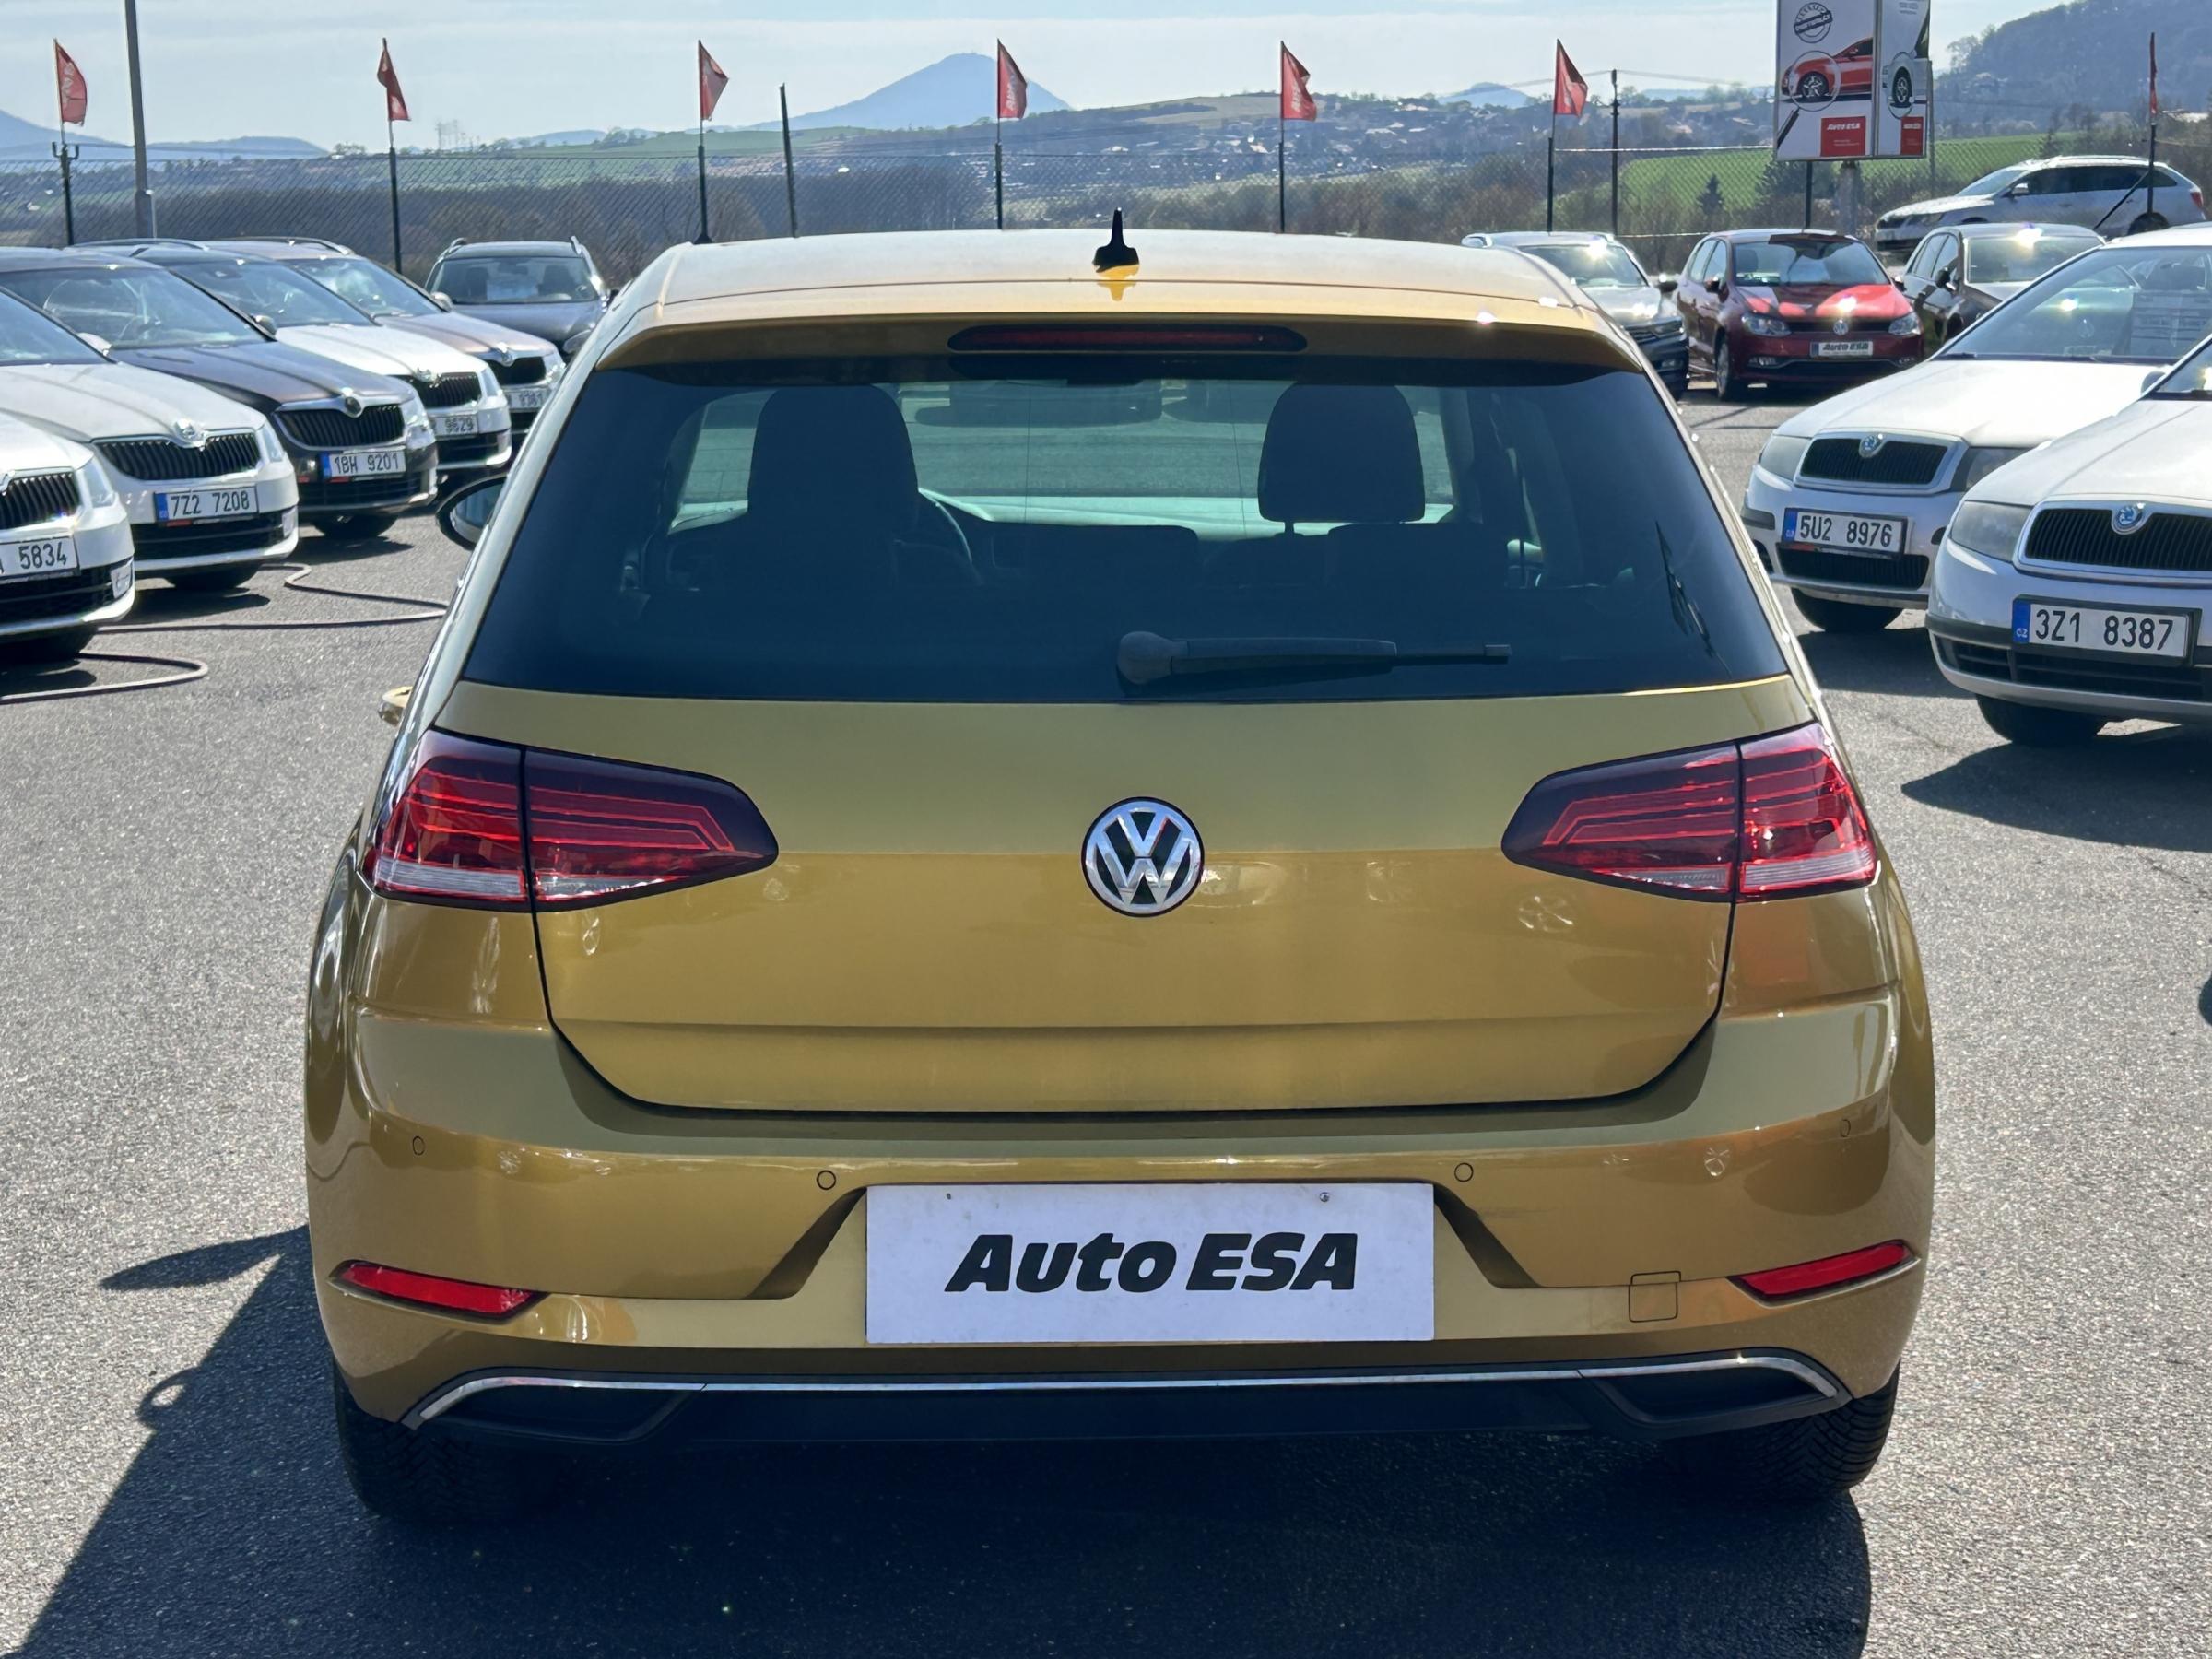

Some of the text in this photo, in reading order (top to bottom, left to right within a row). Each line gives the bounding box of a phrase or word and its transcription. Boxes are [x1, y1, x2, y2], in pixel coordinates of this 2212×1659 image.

[367, 453, 399, 472] 9201
[171, 490, 250, 517] 7Z2 7208
[1800, 514, 1892, 547] 5U2 8976
[18, 541, 67, 570] 5834
[2035, 608, 2081, 643] 3Z1
[2103, 615, 2173, 651] 8387
[944, 1232, 1358, 1293] Auto ESA
